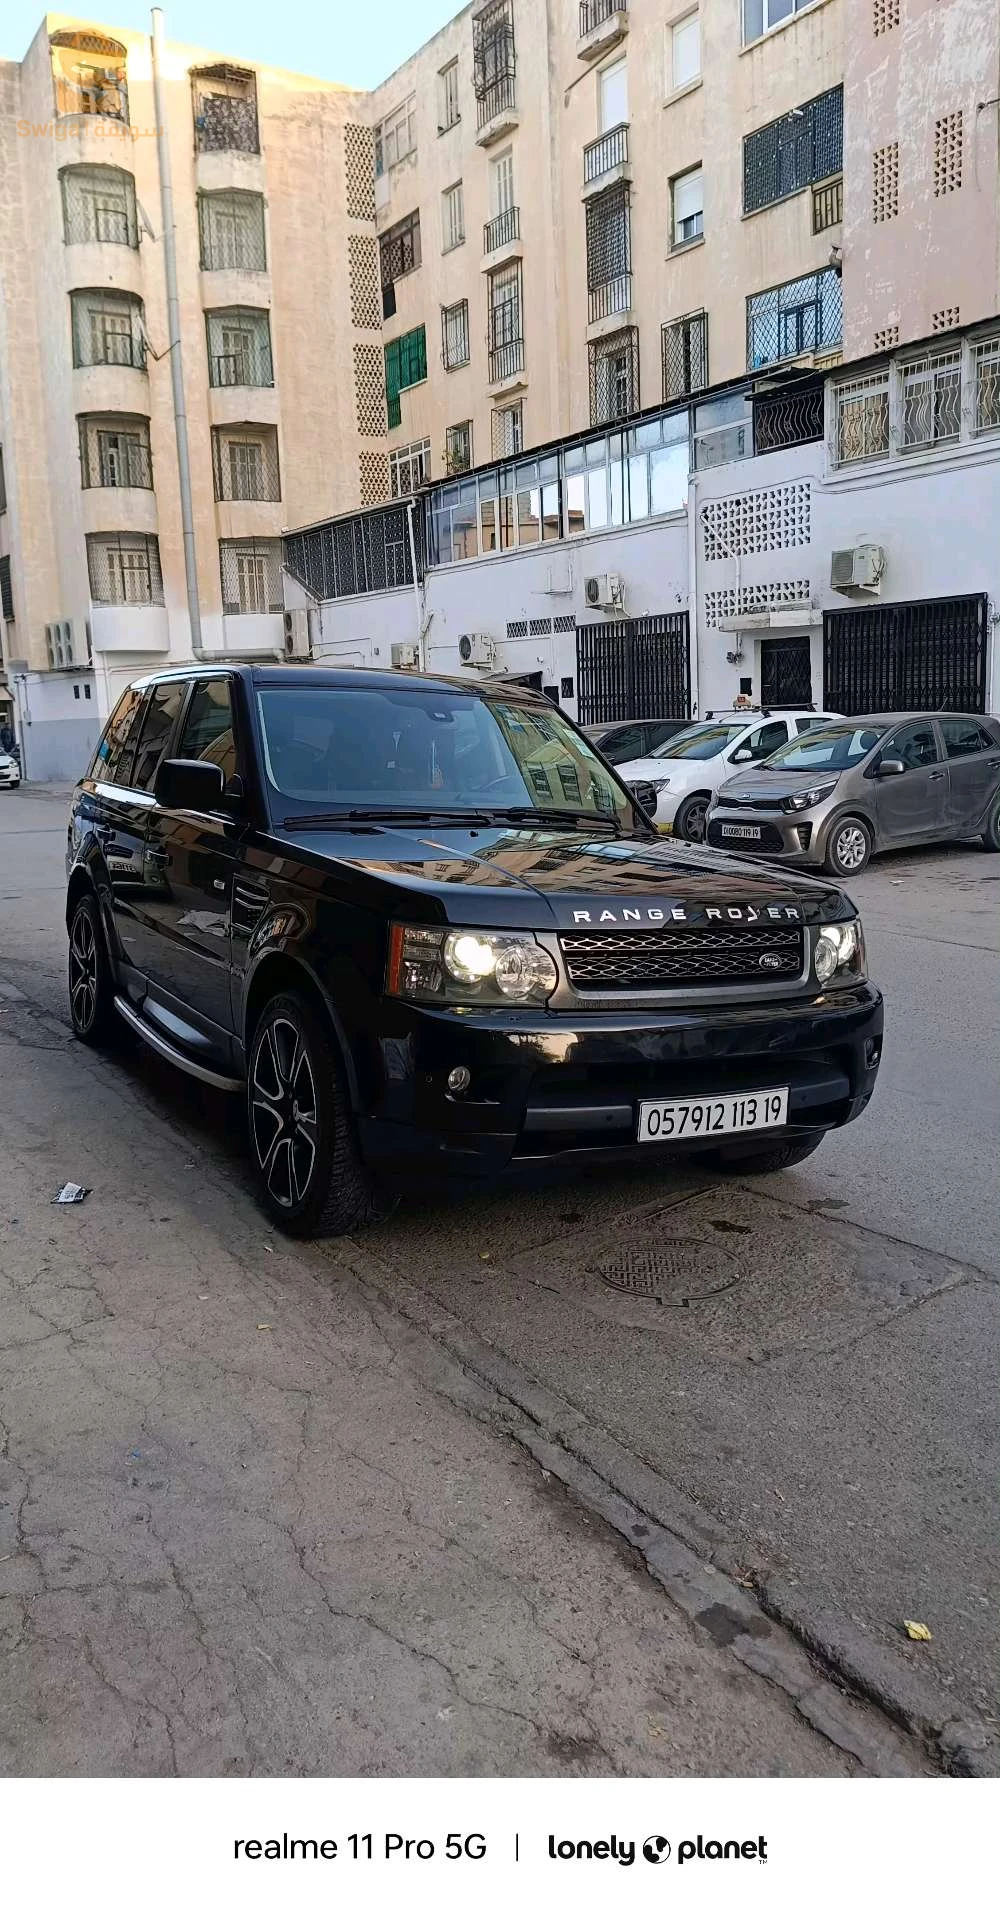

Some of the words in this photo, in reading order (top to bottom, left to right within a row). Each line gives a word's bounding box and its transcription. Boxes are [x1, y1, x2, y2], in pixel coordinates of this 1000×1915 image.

[573, 907, 687, 923] RANGE
[707, 905, 800, 922] ROVER
[647, 1102, 725, 1136] 057912
[732, 1098, 758, 1128] 113
[764, 1095, 782, 1123] 19
